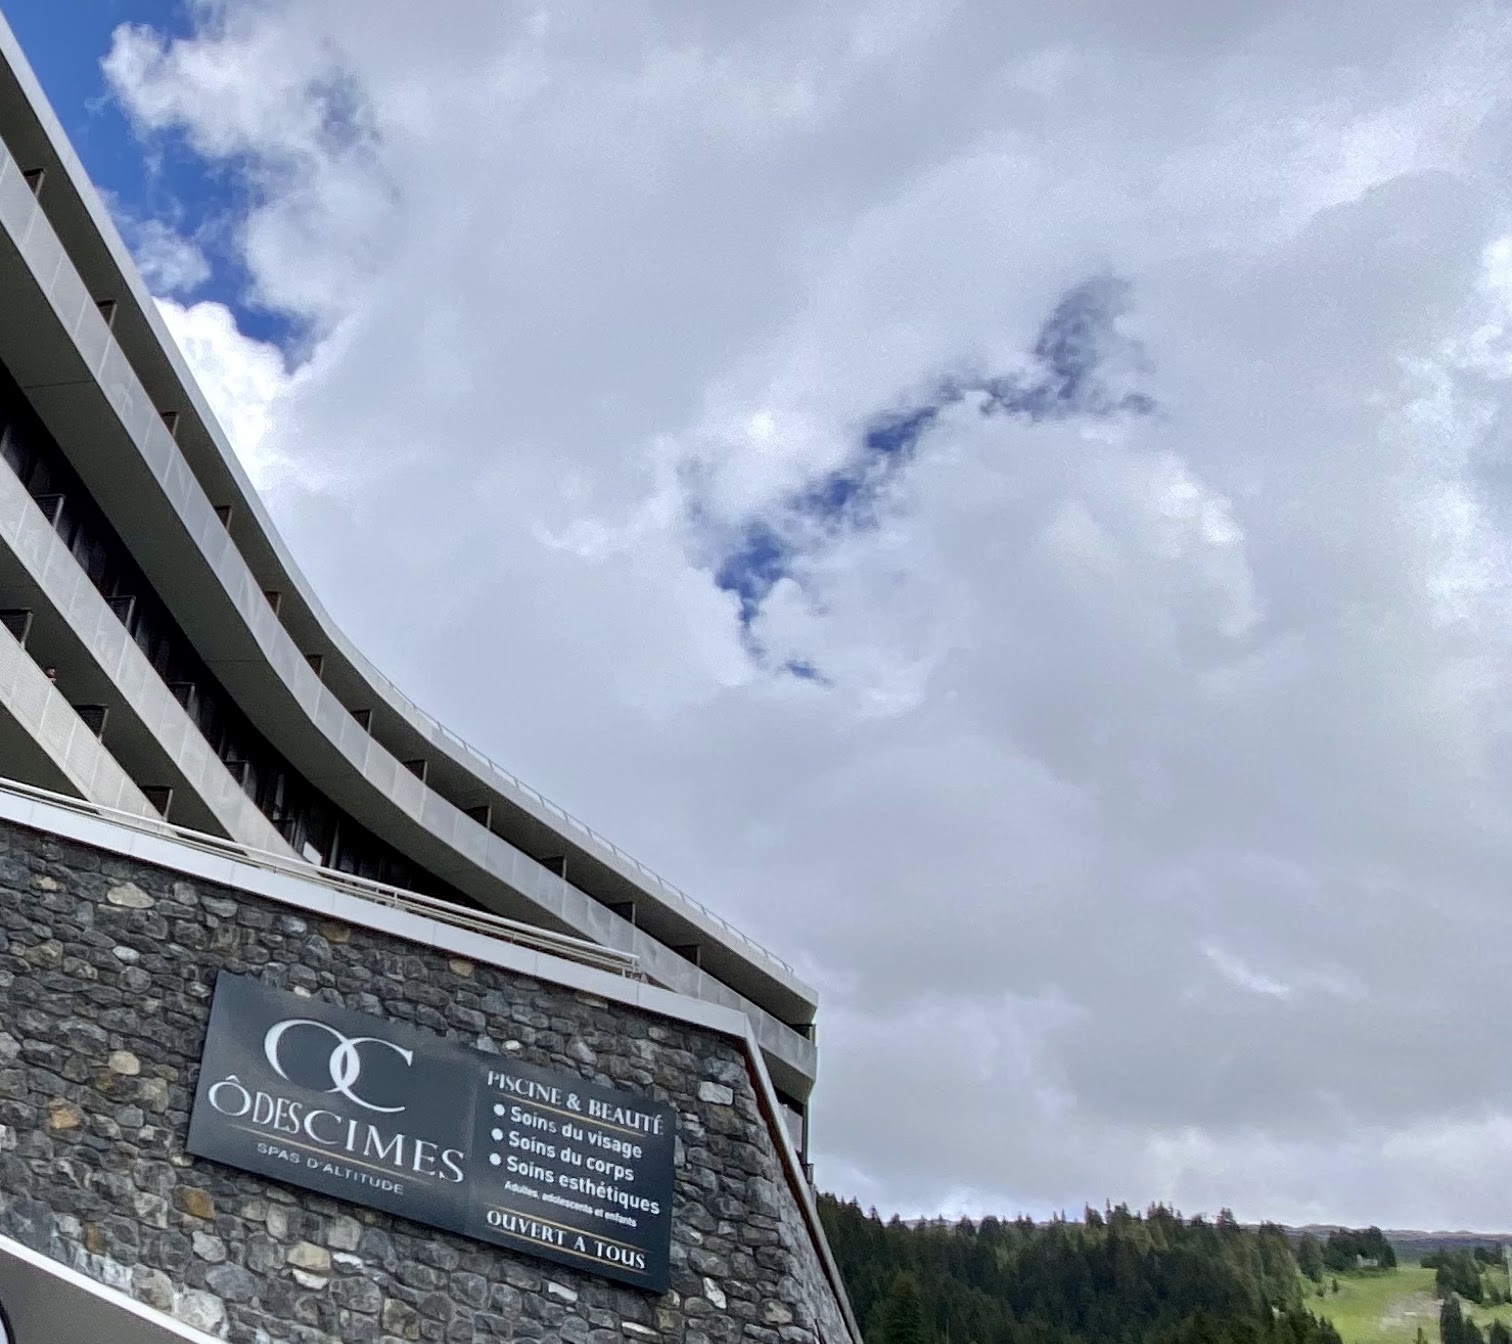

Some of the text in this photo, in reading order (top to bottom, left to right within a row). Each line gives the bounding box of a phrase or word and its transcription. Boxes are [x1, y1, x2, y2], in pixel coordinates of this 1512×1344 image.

[488, 1070, 664, 1136] PISCINE & BEAUTÉ
[508, 1130, 635, 1182] Soins du corps
[510, 1106, 643, 1159] Soins du visage
[257, 1142, 404, 1196] SPAS D'ALTITUDE
[506, 1155, 660, 1215] Soins esthétiques
[541, 1192, 593, 1215] adolescents
[594, 1208, 604, 1218] et
[604, 1211, 637, 1228] enfants
[487, 1210, 646, 1270] OUVERT A TOUS
